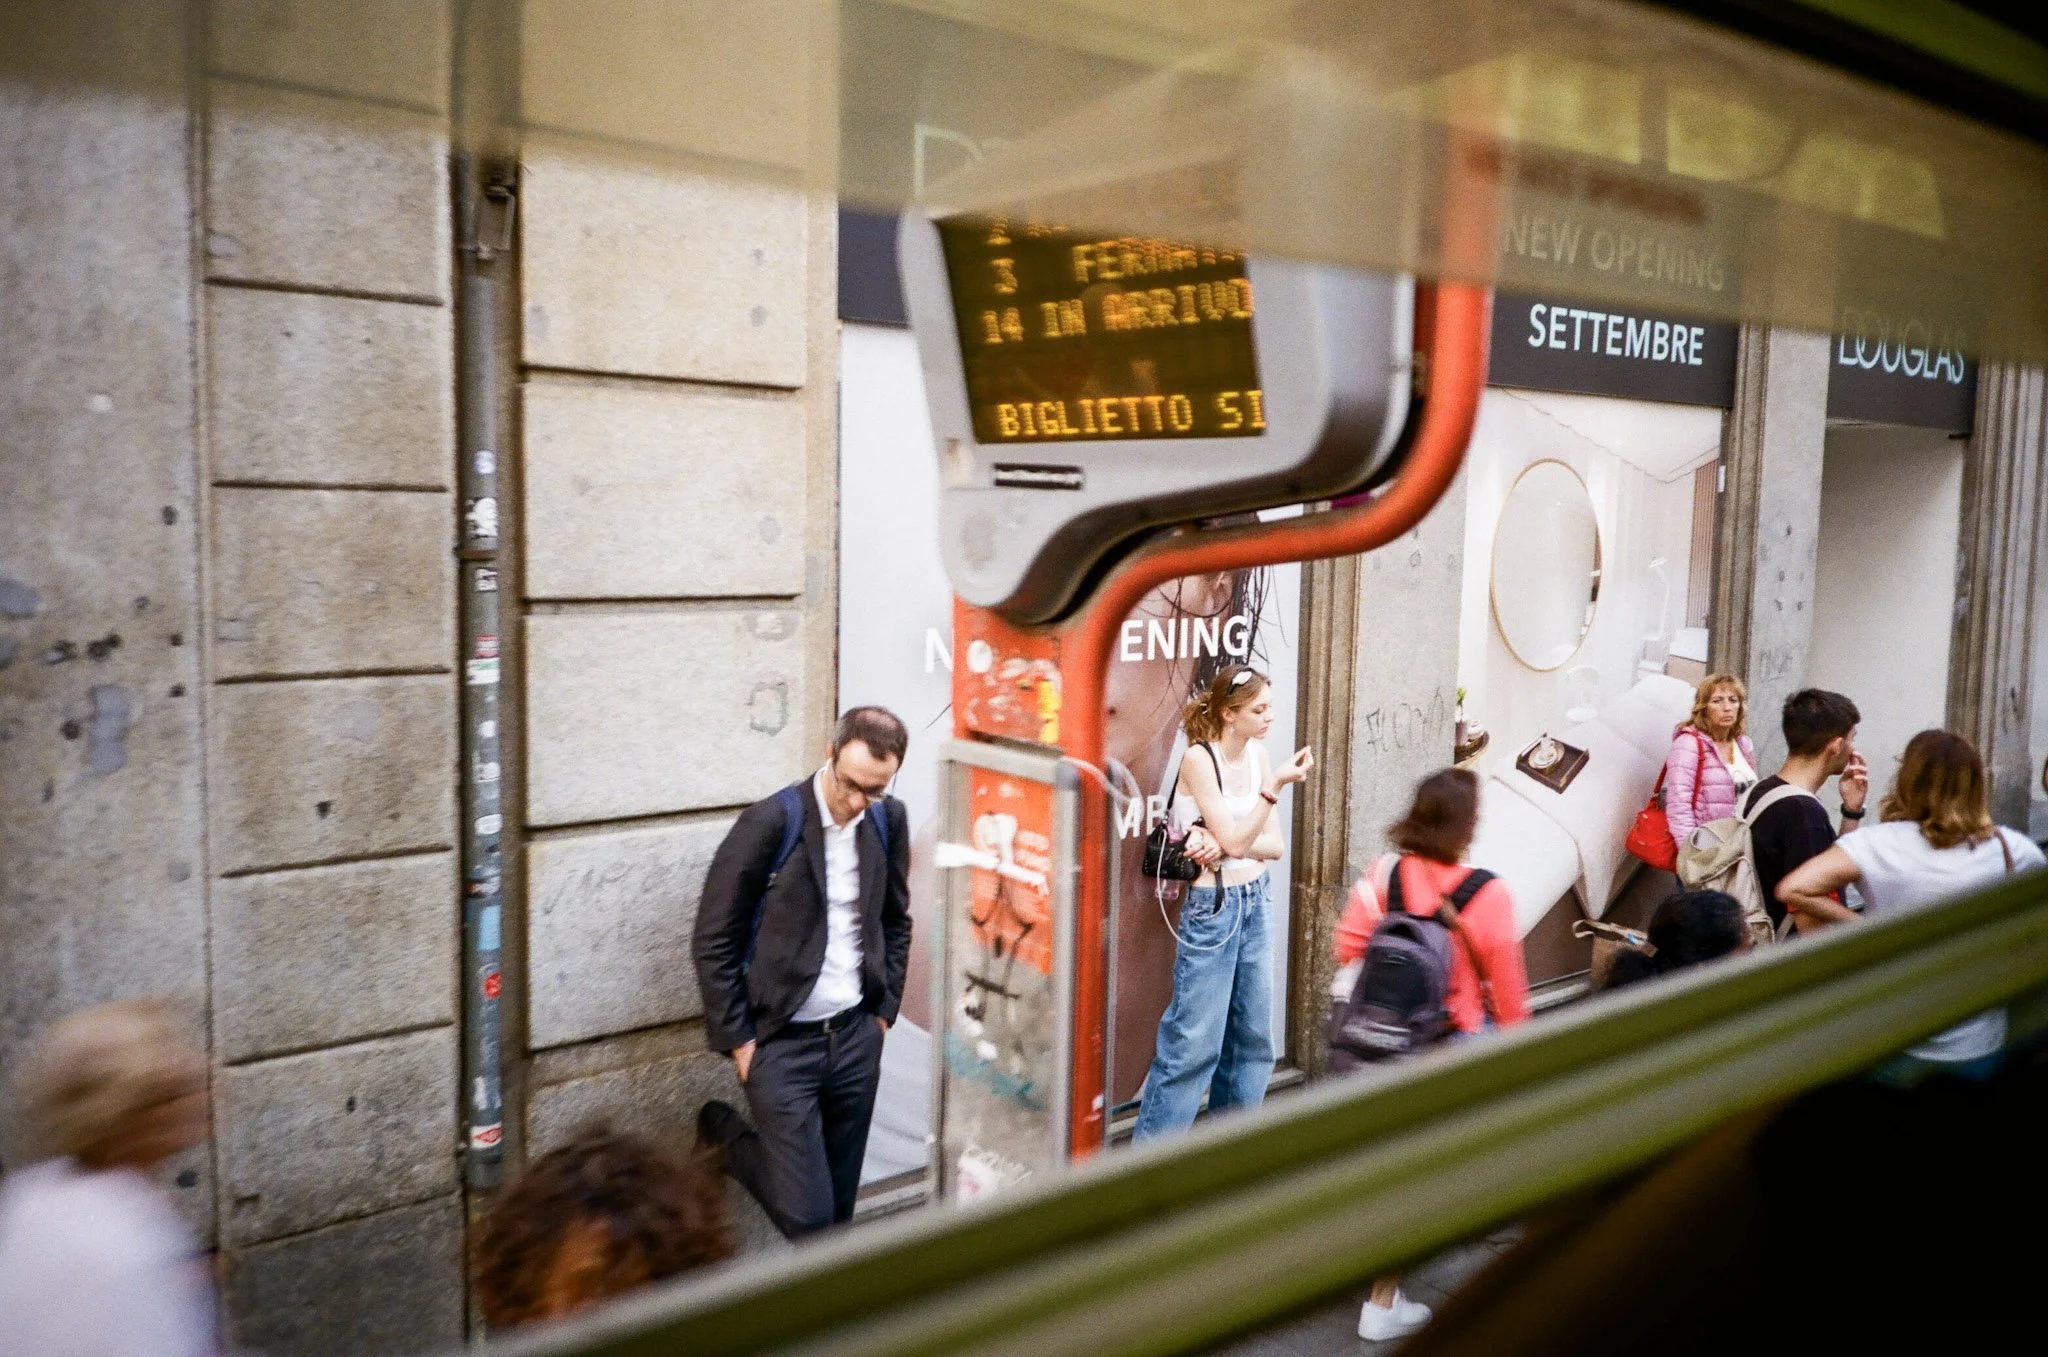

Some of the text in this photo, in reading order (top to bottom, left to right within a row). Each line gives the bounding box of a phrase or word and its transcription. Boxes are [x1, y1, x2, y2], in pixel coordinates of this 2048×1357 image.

[982, 277, 1254, 344] 14 IN ARRIVO
[1527, 303, 1704, 366] SETTEMBRE
[997, 394, 1194, 437] BIGLIETTO
[1119, 614, 1250, 663] ENING
